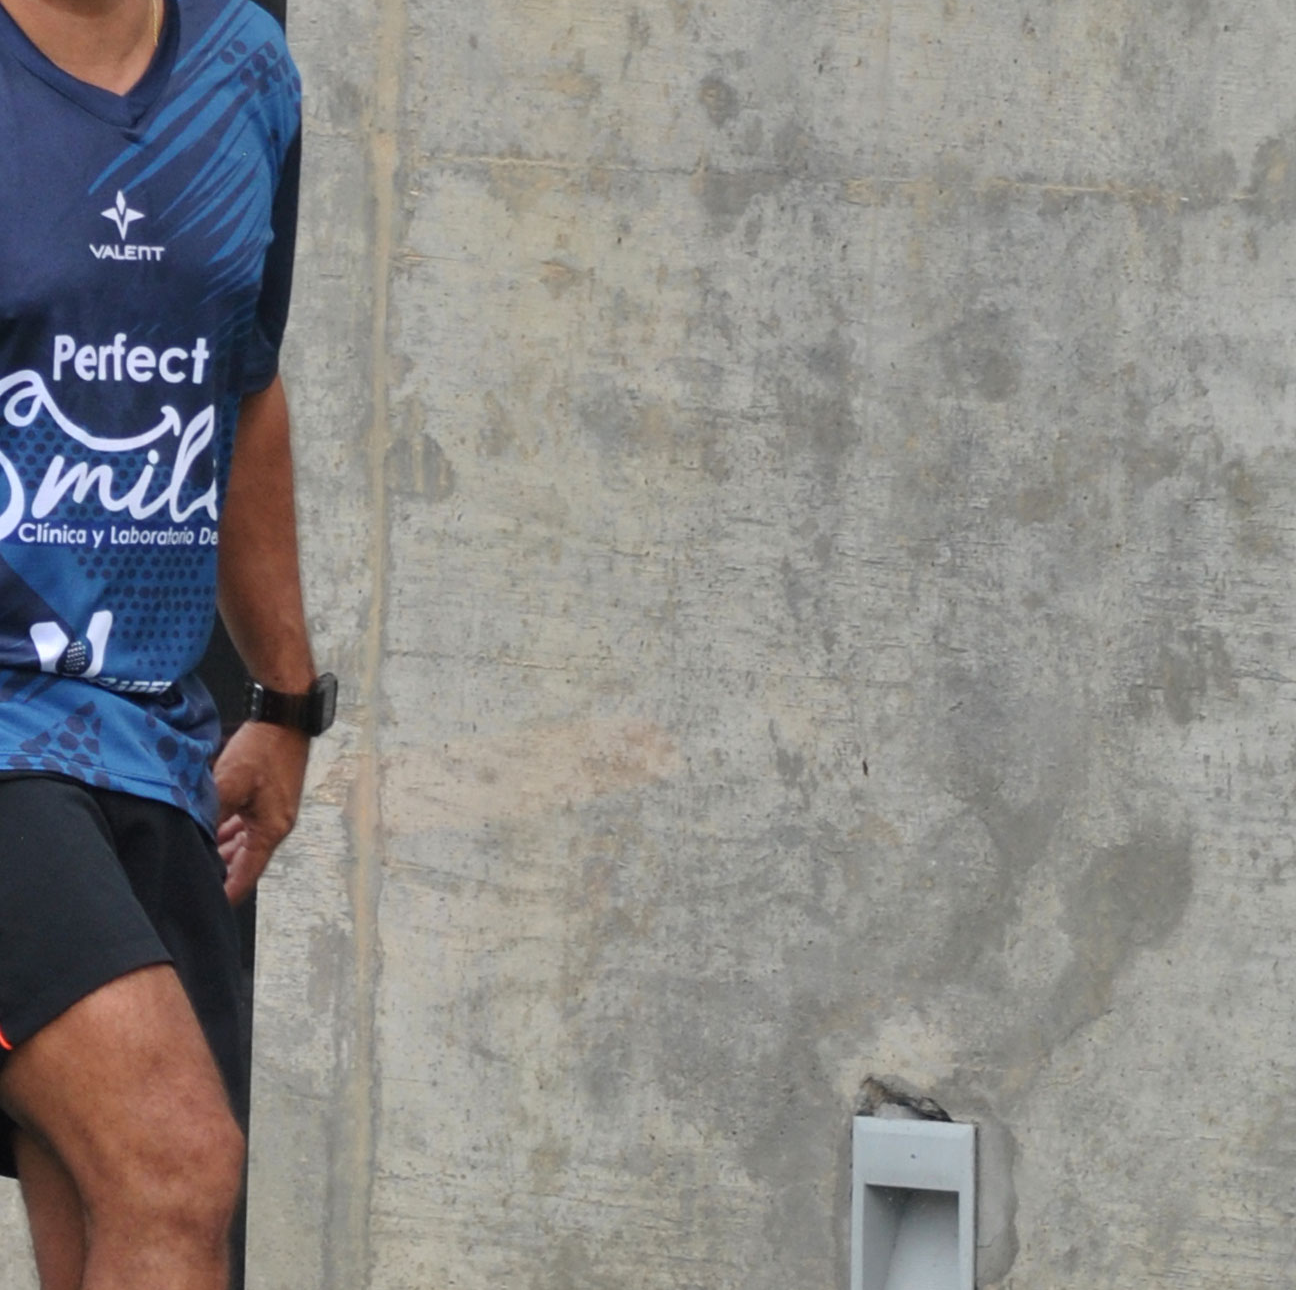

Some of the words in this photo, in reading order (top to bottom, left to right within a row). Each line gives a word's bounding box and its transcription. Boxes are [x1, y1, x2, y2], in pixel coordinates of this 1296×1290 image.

[89, 244, 165, 261] VALENT
[53, 333, 209, 384] Perfect
[18, 522, 86, 544] Clínica
[92, 530, 104, 548] y
[111, 526, 194, 545] Laboratorio
